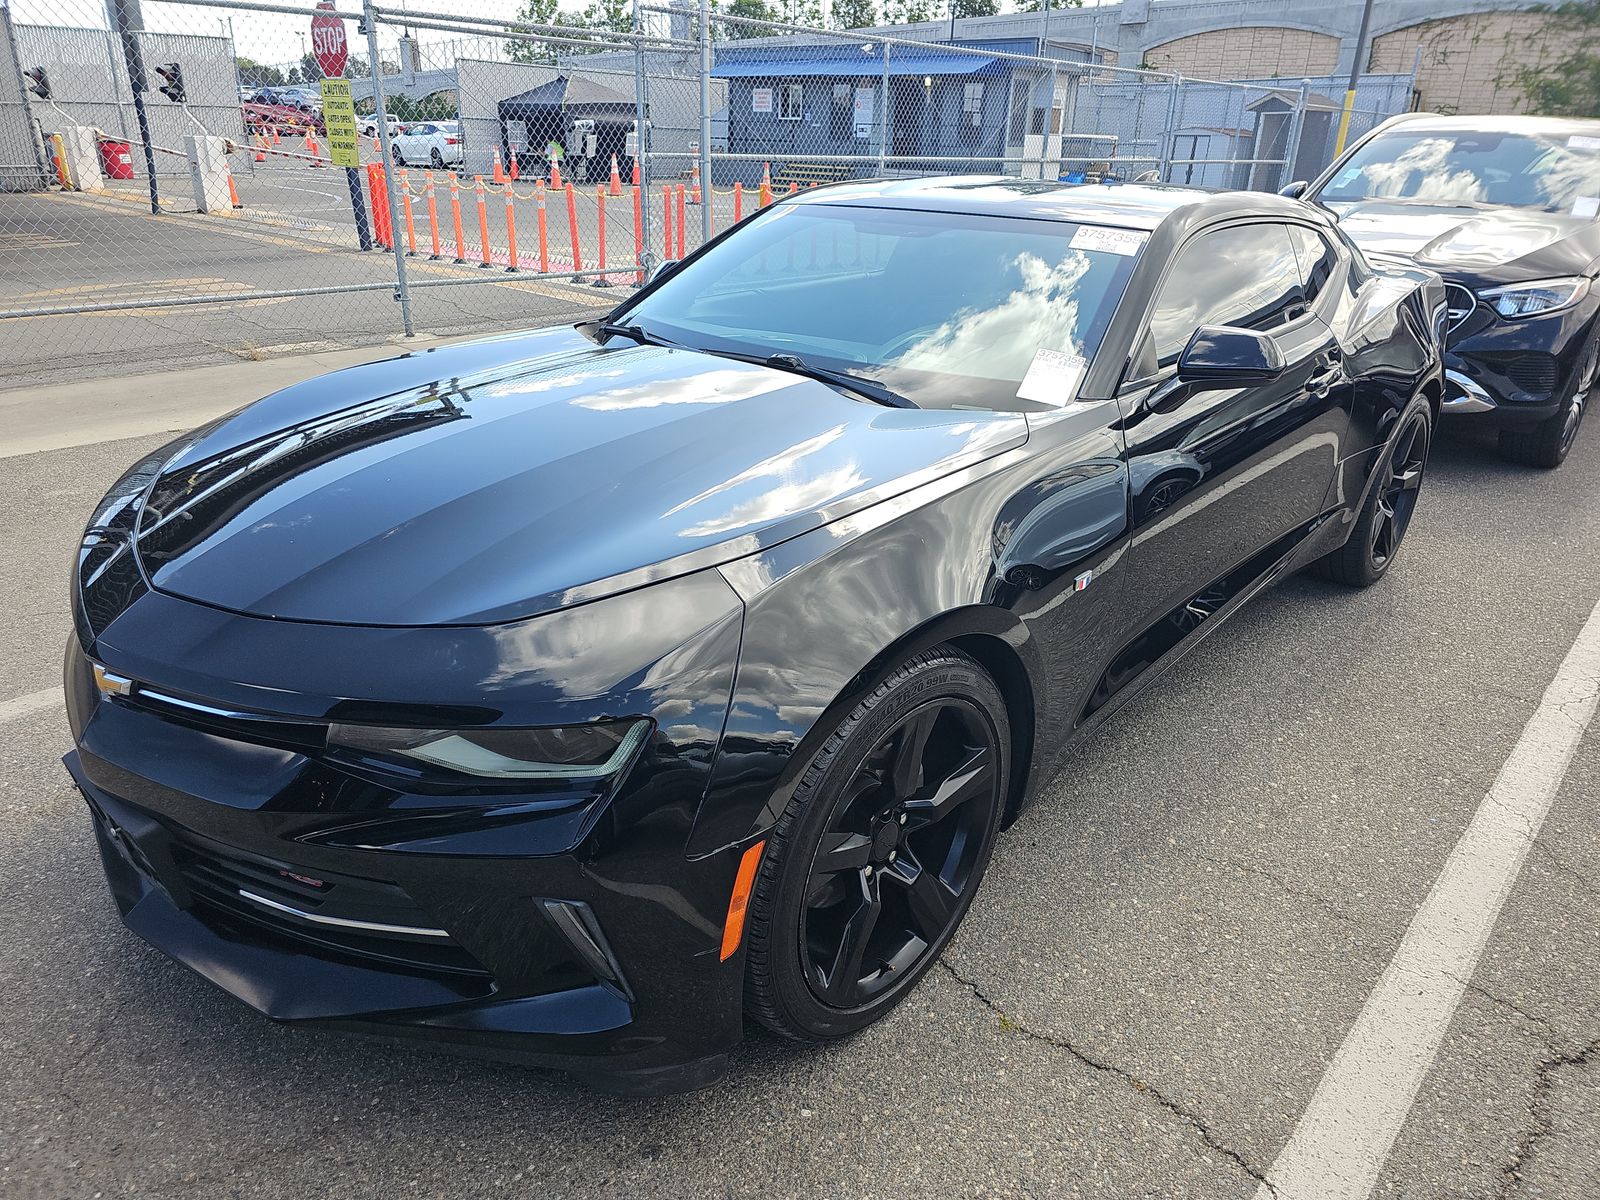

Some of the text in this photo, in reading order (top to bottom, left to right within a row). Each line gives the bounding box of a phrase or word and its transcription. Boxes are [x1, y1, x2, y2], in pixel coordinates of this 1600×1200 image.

[313, 26, 345, 55] STOP
[323, 83, 350, 96] CAUTION
[1078, 228, 1143, 244] 3757359
[1038, 349, 1085, 366] 3757359
[926, 673, 949, 688] 99W
